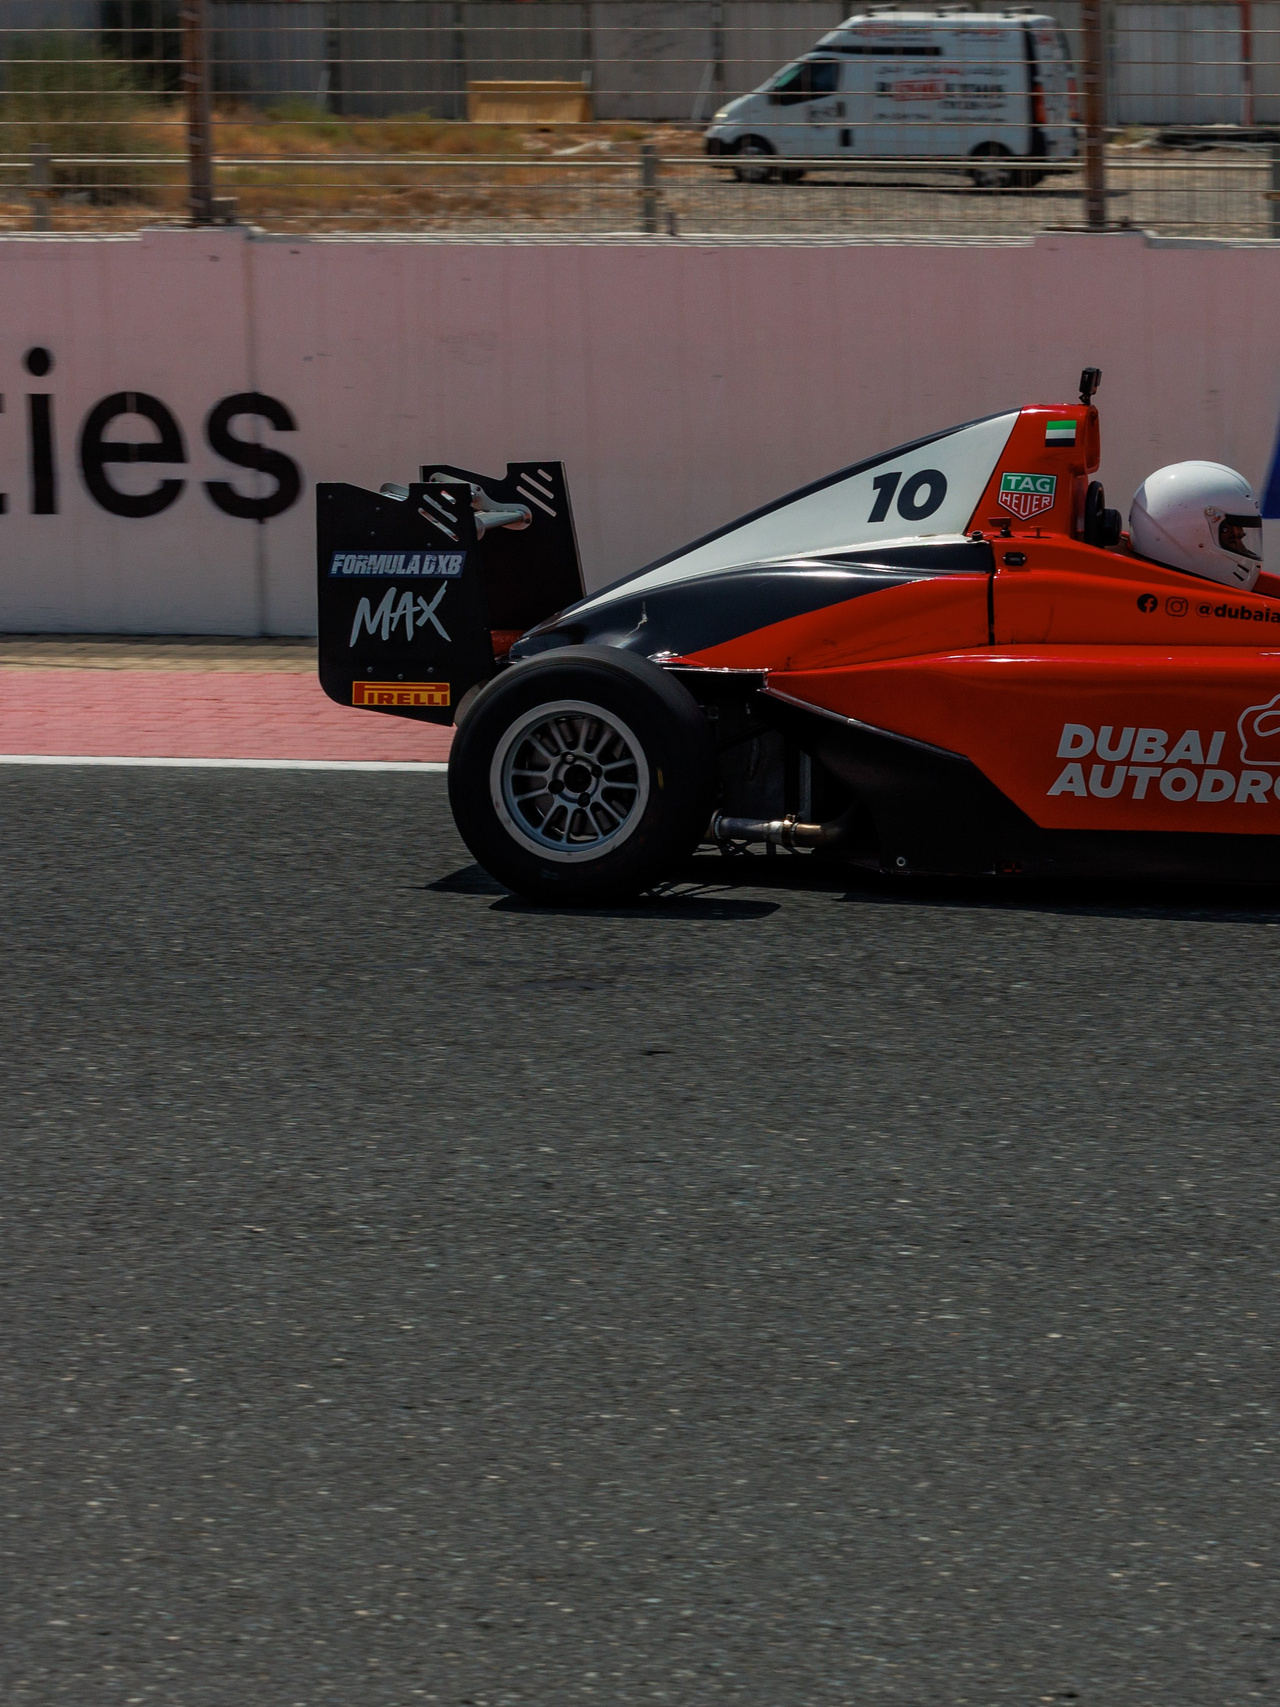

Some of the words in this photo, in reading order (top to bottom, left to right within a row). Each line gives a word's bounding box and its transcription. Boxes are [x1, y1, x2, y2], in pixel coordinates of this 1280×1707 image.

[867, 468, 948, 523] 10
[1006, 475, 1051, 493] TAG
[1001, 493, 1051, 516] HEUER
[331, 554, 423, 575] FORMULA
[421, 554, 463, 575] DXB
[349, 580, 452, 648] MAX
[353, 682, 450, 706] PIRELLI
[1056, 723, 1227, 766] DUBAI
